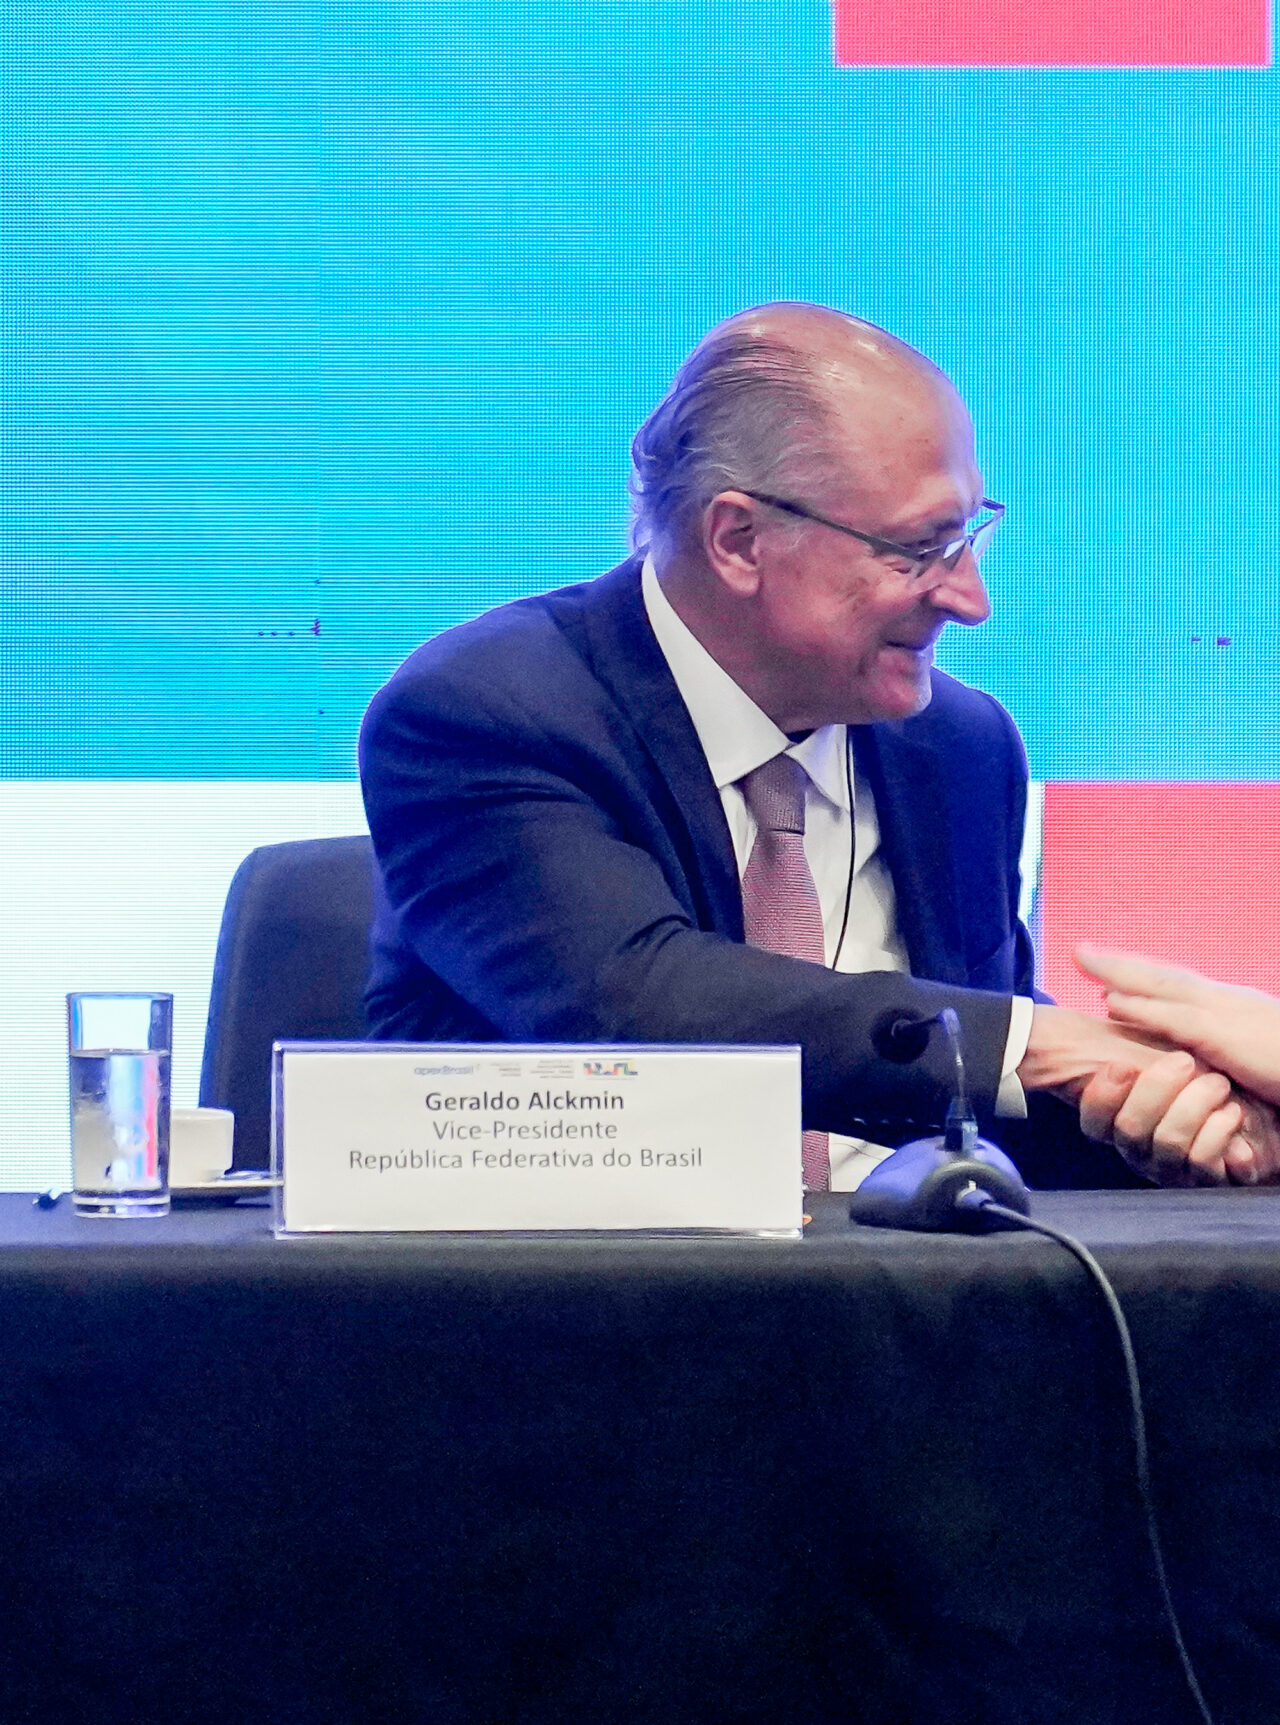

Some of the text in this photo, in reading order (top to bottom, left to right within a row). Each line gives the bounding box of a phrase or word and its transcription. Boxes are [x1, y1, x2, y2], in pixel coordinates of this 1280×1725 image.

[424, 1090, 625, 1111] Geraldo Alckmin
[432, 1119, 618, 1141] Vice-Presidente
[349, 1147, 702, 1174] República Federativa do Brasil
